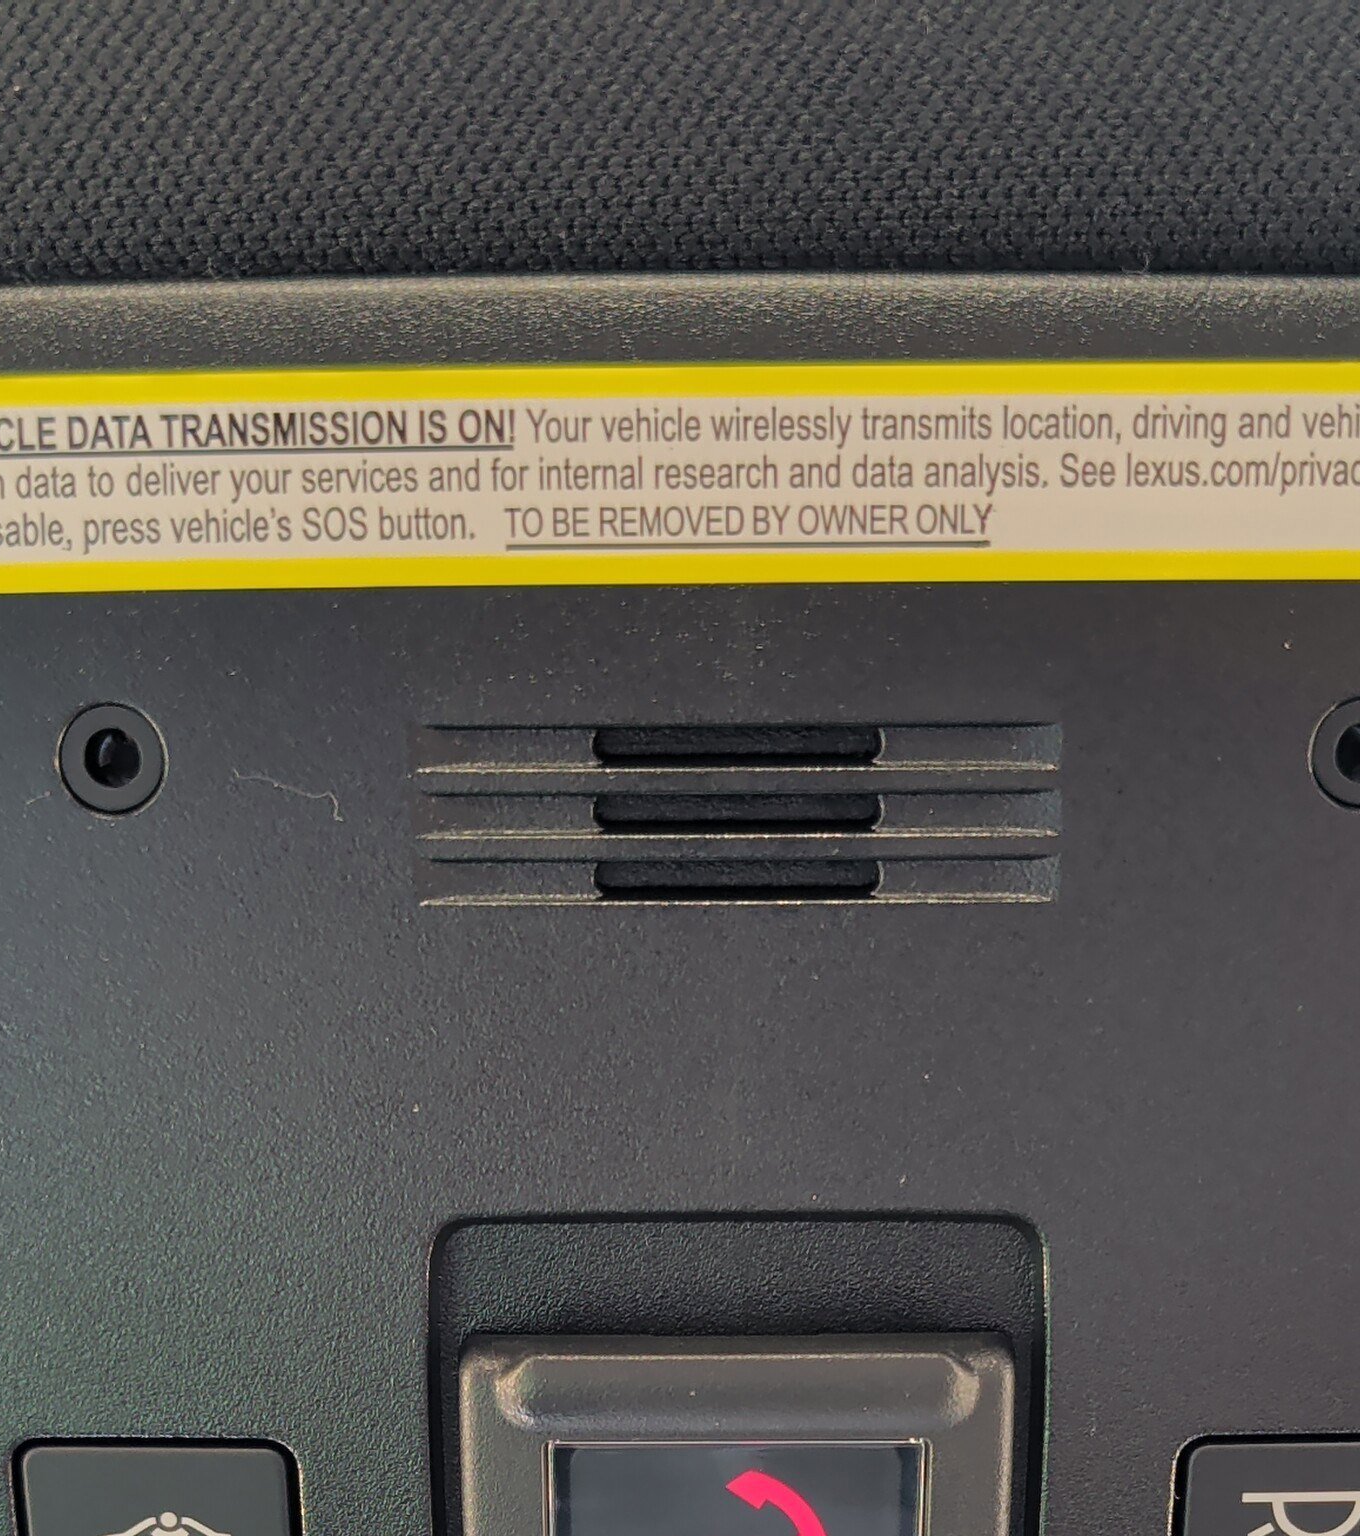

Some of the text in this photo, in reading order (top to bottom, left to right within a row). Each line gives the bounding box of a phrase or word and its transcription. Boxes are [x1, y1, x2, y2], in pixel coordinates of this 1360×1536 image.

[67, 413, 152, 451] DATA
[160, 410, 410, 448] TRANSMISSION
[417, 408, 448, 445] IS
[457, 407, 516, 444] ON!
[524, 406, 594, 444] Your
[600, 405, 702, 444] vehicle
[709, 405, 853, 451] wirelessly
[860, 404, 993, 442] transmits
[1002, 403, 1123, 446] location,
[1131, 403, 1228, 449] driving
[1236, 403, 1292, 440] and
[14, 464, 78, 500] data
[86, 464, 116, 499] to
[125, 461, 223, 498] deliver
[229, 468, 293, 500] your
[300, 457, 420, 495] services
[427, 456, 481, 493] and
[489, 456, 531, 493] for
[538, 453, 644, 492] internal
[653, 452, 779, 491] research
[788, 452, 842, 490] and
[851, 452, 914, 490] data
[923, 451, 1049, 498] analysis.
[1058, 450, 1117, 489] See
[82, 516, 162, 553] press
[169, 505, 293, 544] vehicle's
[301, 504, 369, 543] SOS
[377, 504, 477, 542] button.
[502, 505, 544, 539] TO
[551, 506, 591, 538] BE
[598, 503, 746, 538] REMOVED
[751, 504, 792, 537] BY
[797, 503, 910, 536] OWNER
[915, 502, 994, 536] ONLY
